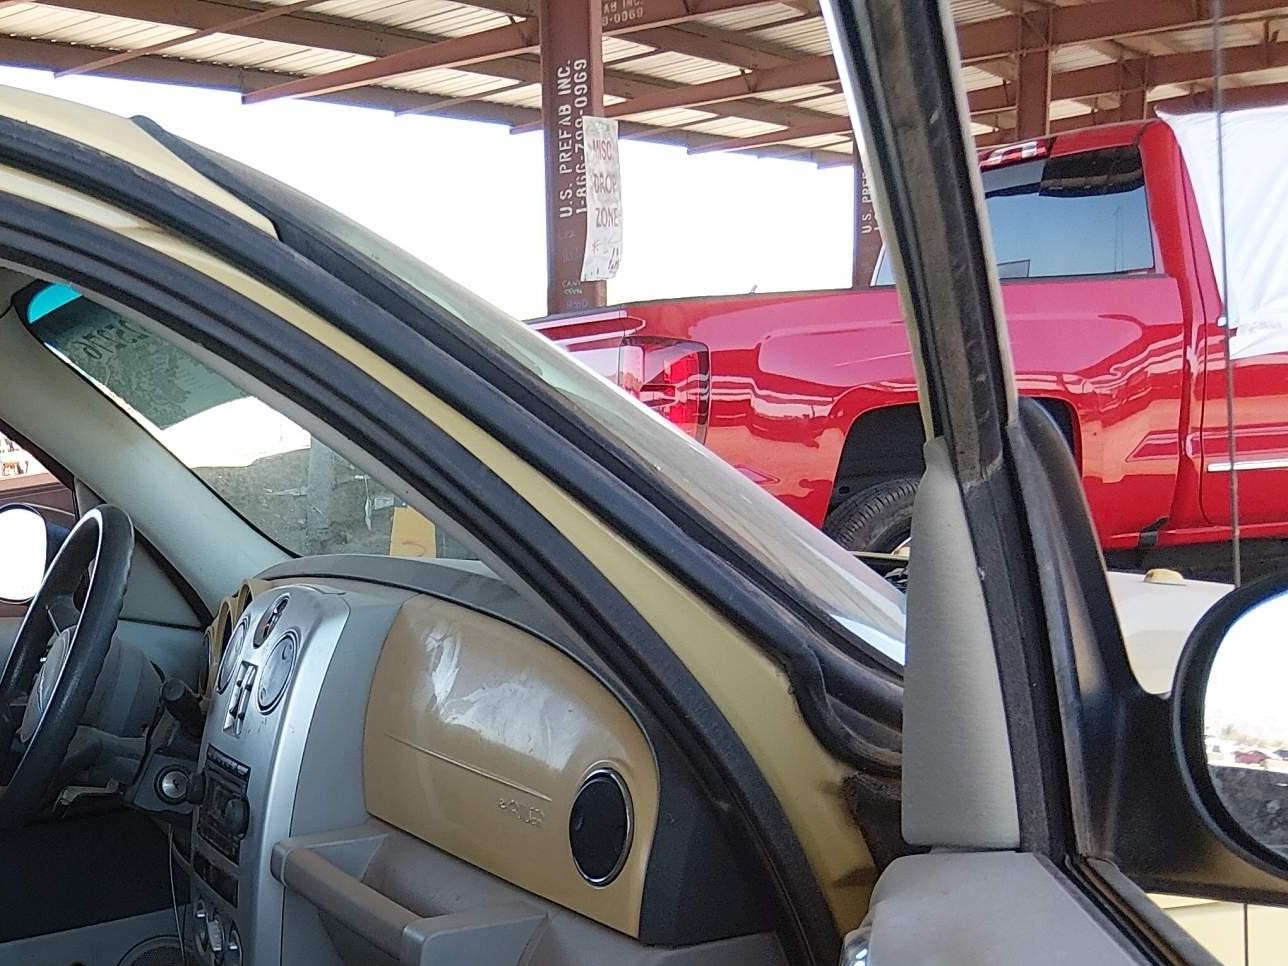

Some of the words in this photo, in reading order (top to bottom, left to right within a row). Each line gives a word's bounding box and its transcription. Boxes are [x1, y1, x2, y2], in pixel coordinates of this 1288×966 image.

[557, 59, 572, 93] INC.
[558, 104, 573, 174] PREFAB
[593, 172, 617, 193] DROP
[559, 183, 573, 218] U.S.
[595, 207, 619, 228] ZONE
[861, 208, 872, 234] U.S.
